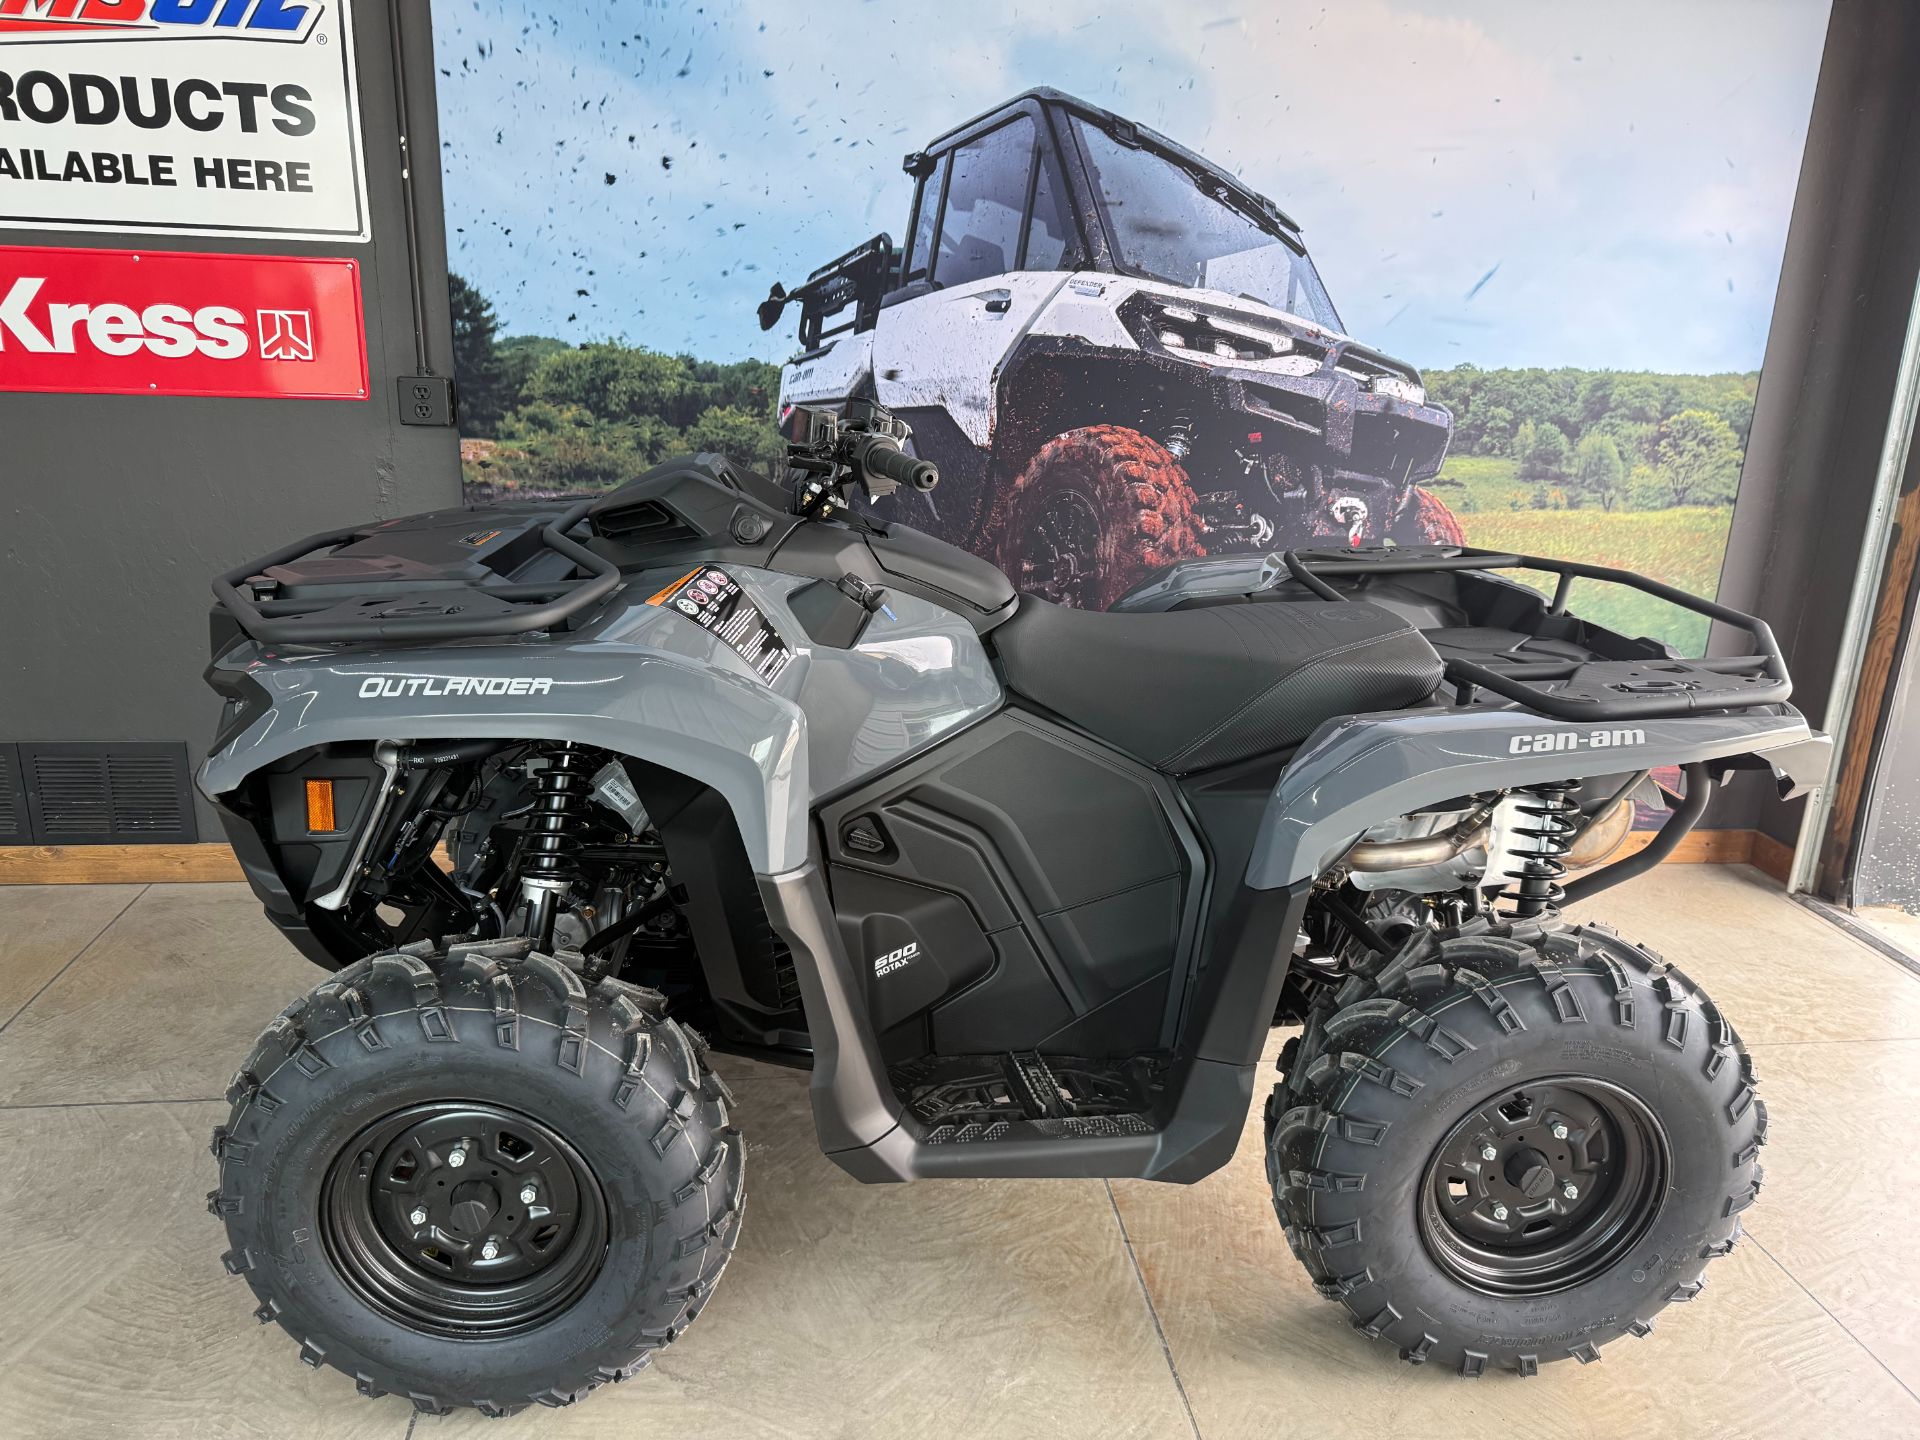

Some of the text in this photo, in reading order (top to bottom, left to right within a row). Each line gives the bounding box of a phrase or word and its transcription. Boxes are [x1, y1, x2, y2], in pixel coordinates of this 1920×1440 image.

[193, 156, 313, 193] HERE
[0, 276, 249, 360] Kress
[359, 677, 553, 698] OUTLANDER
[1508, 728, 1646, 754] can-am
[875, 957, 909, 978] ROTAX
